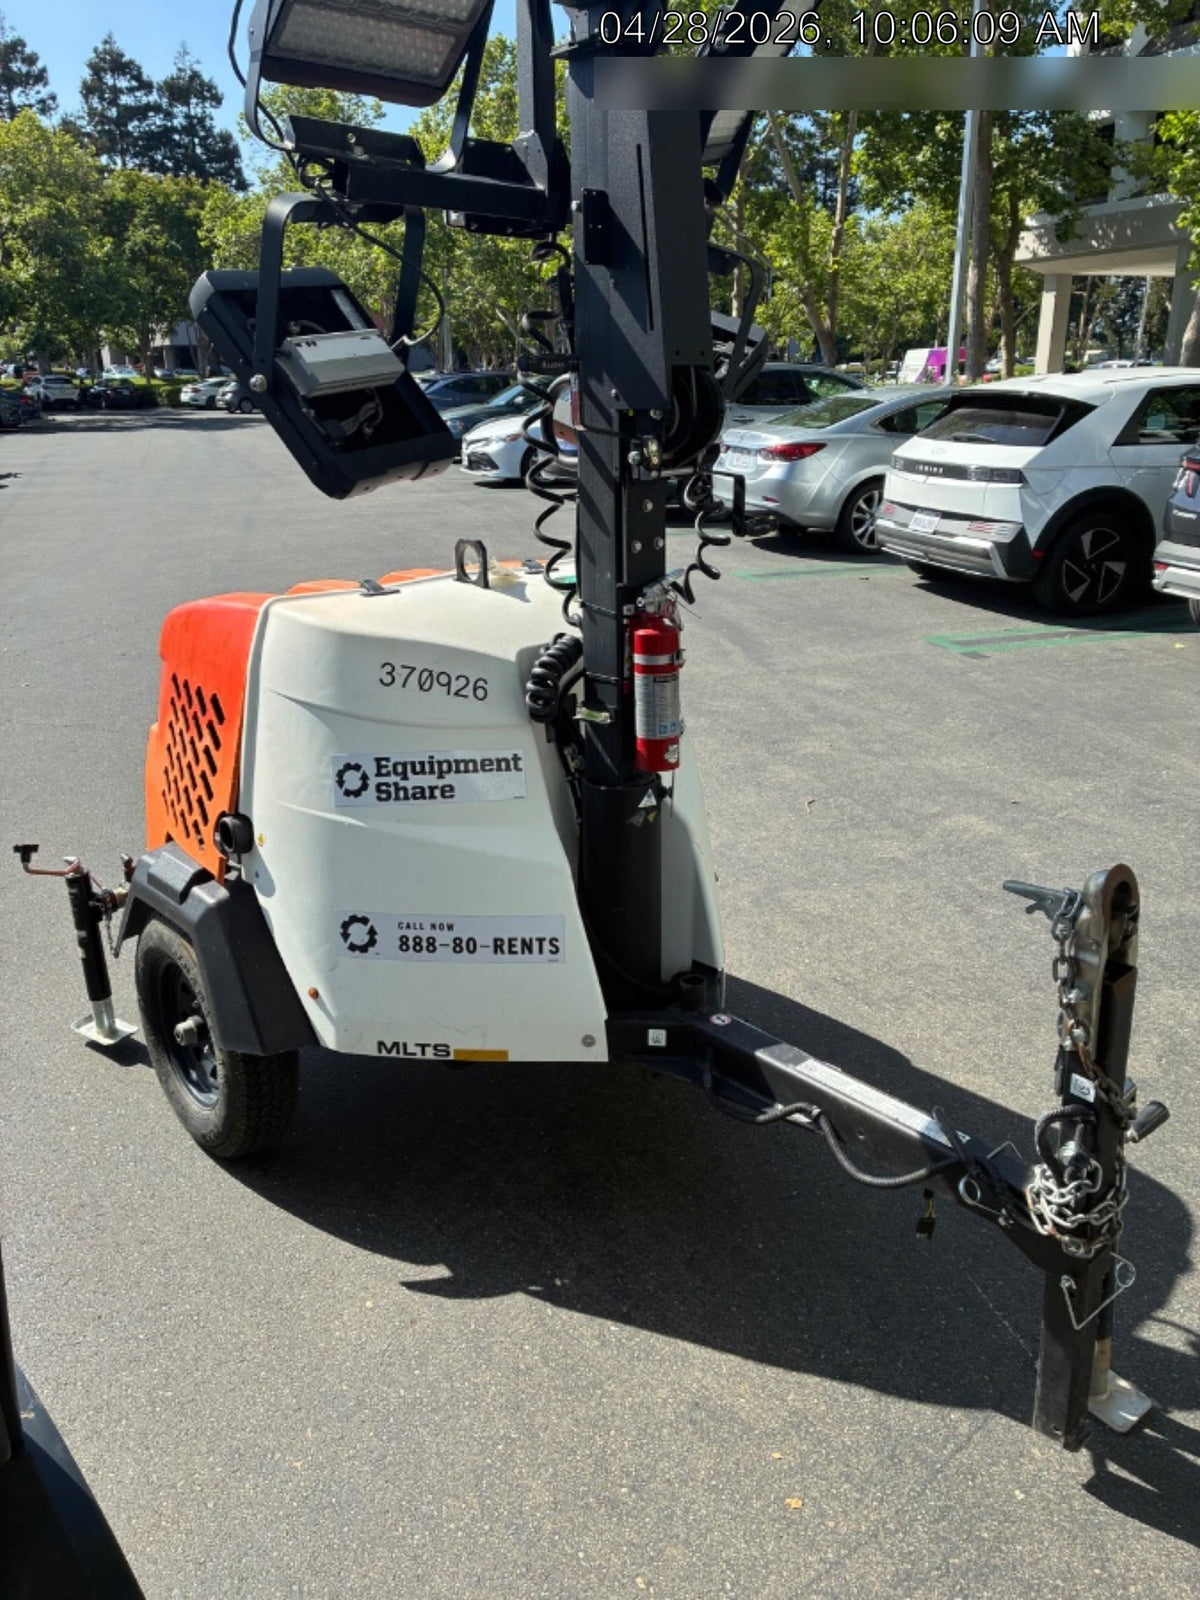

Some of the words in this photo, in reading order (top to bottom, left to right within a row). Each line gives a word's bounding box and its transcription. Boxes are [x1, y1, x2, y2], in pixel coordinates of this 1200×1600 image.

[379, 662, 489, 701] 370926
[374, 753, 523, 781] Equipment
[374, 782, 456, 802] Share
[397, 921, 425, 931] CALL
[429, 922, 455, 932] NOW
[398, 935, 560, 956] 888-80-RENTS
